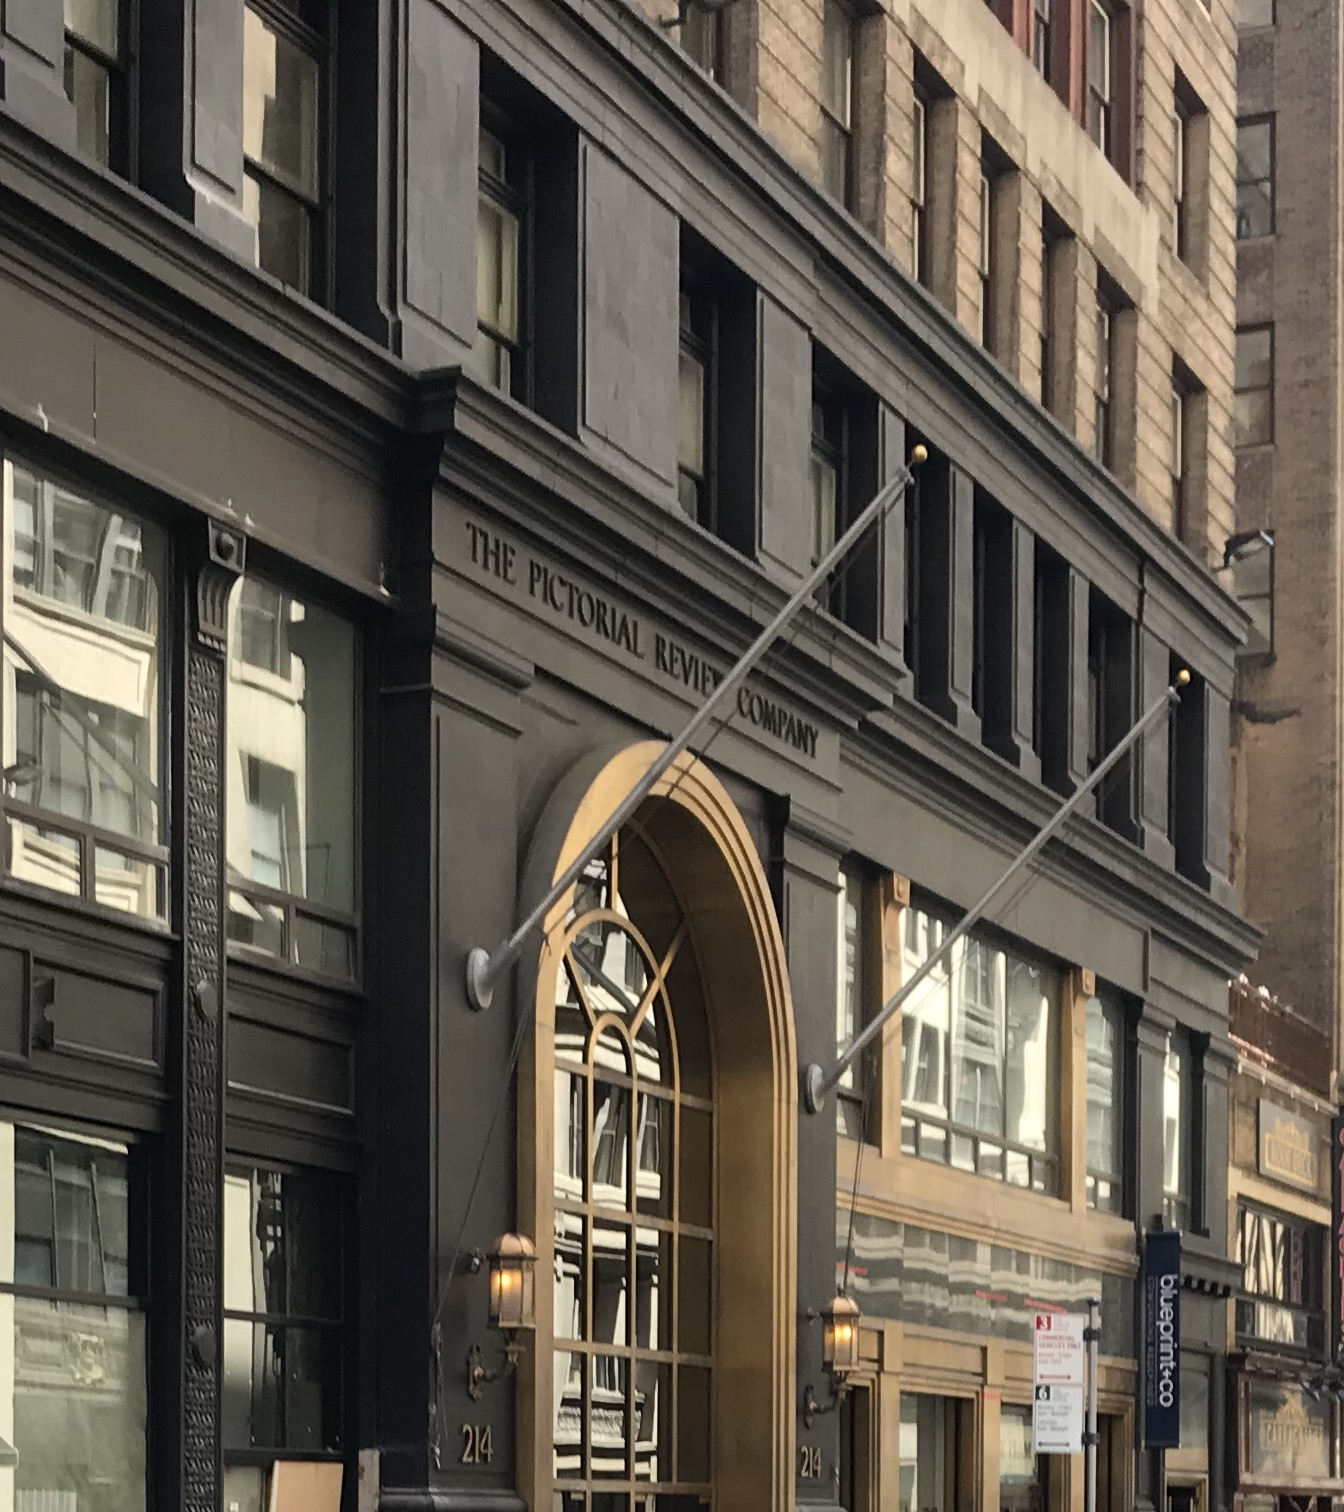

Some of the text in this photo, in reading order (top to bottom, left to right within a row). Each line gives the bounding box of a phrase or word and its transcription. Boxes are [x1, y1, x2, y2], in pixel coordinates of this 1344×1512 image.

[466, 521, 517, 586] THE
[529, 559, 644, 660] PICTORIAL
[736, 686, 819, 759] COMPANY
[1156, 1273, 1179, 1408] blueprint+co
[1038, 1386, 1048, 1400] 6
[462, 1424, 494, 1464] 214
[800, 1446, 822, 1478] 214
